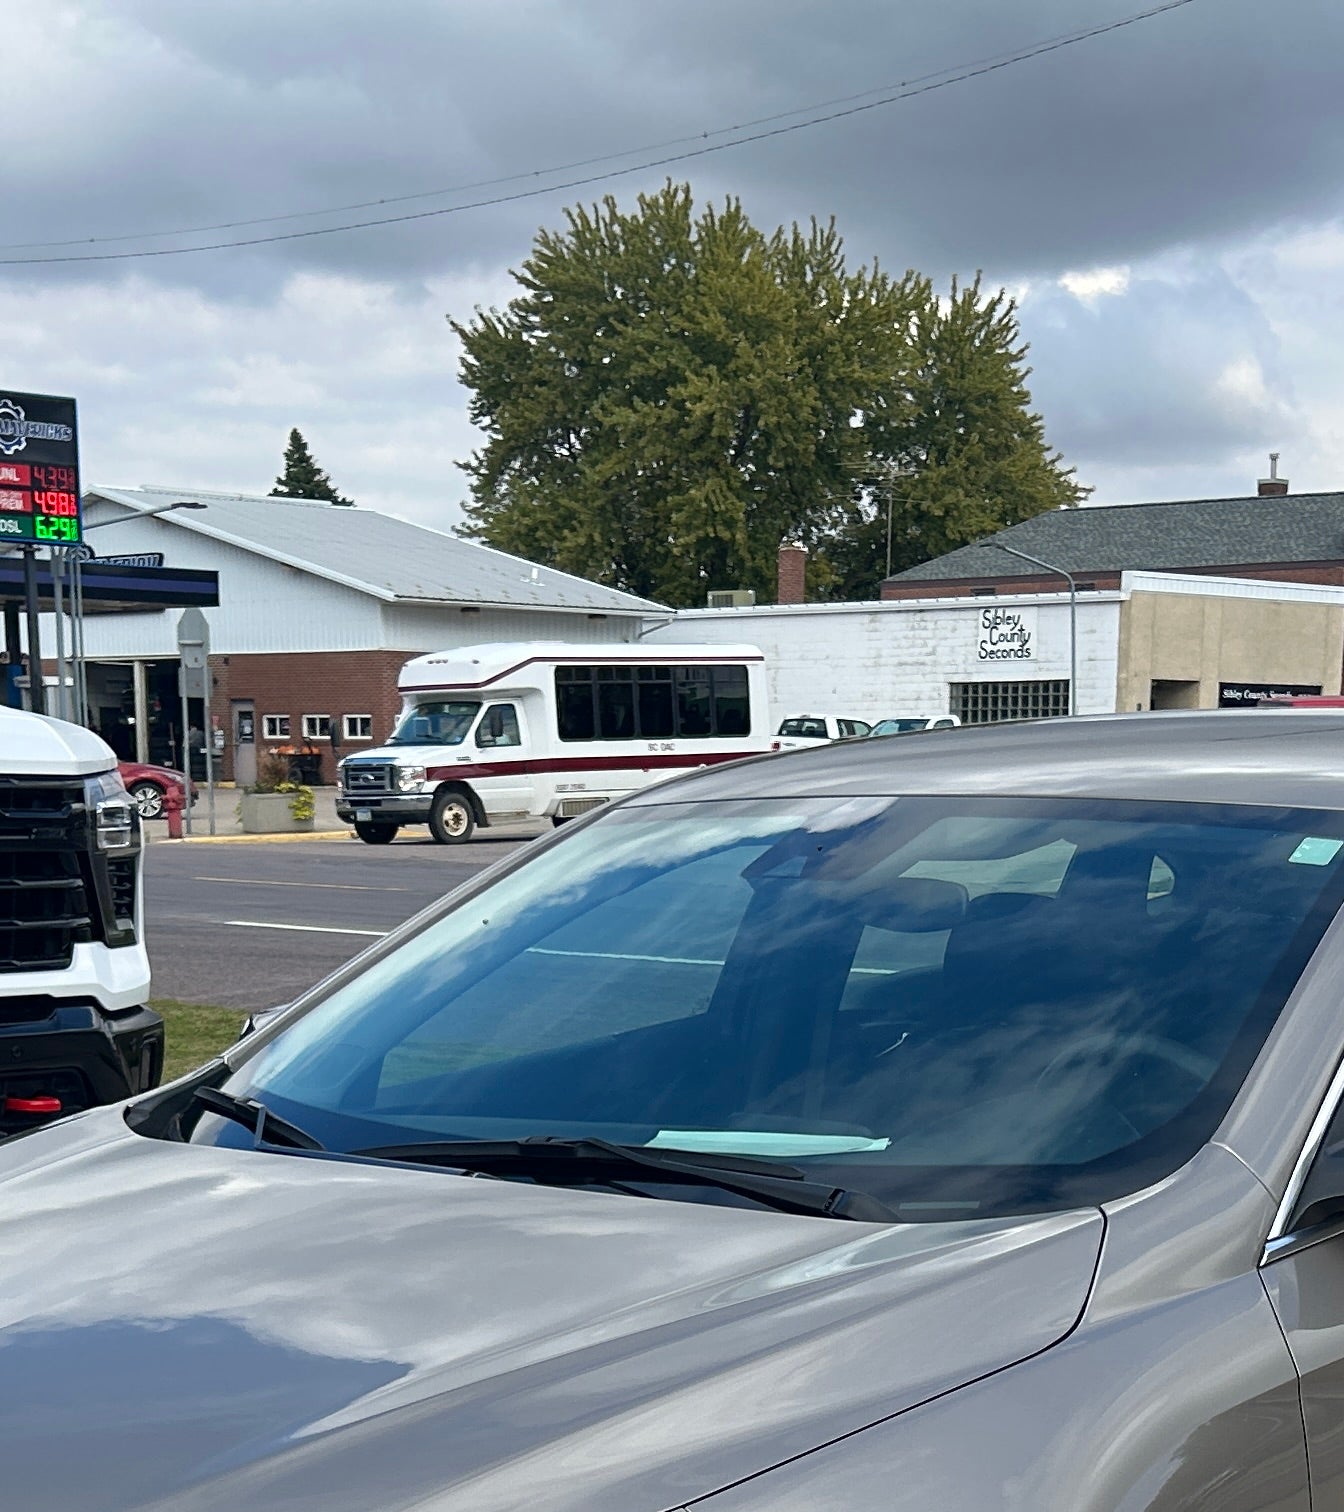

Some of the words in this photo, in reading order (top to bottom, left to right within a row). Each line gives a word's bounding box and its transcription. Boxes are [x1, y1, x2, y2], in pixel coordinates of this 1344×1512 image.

[982, 609, 1021, 631] Sibley
[989, 624, 1032, 648] County
[978, 640, 1032, 660] Seconds
